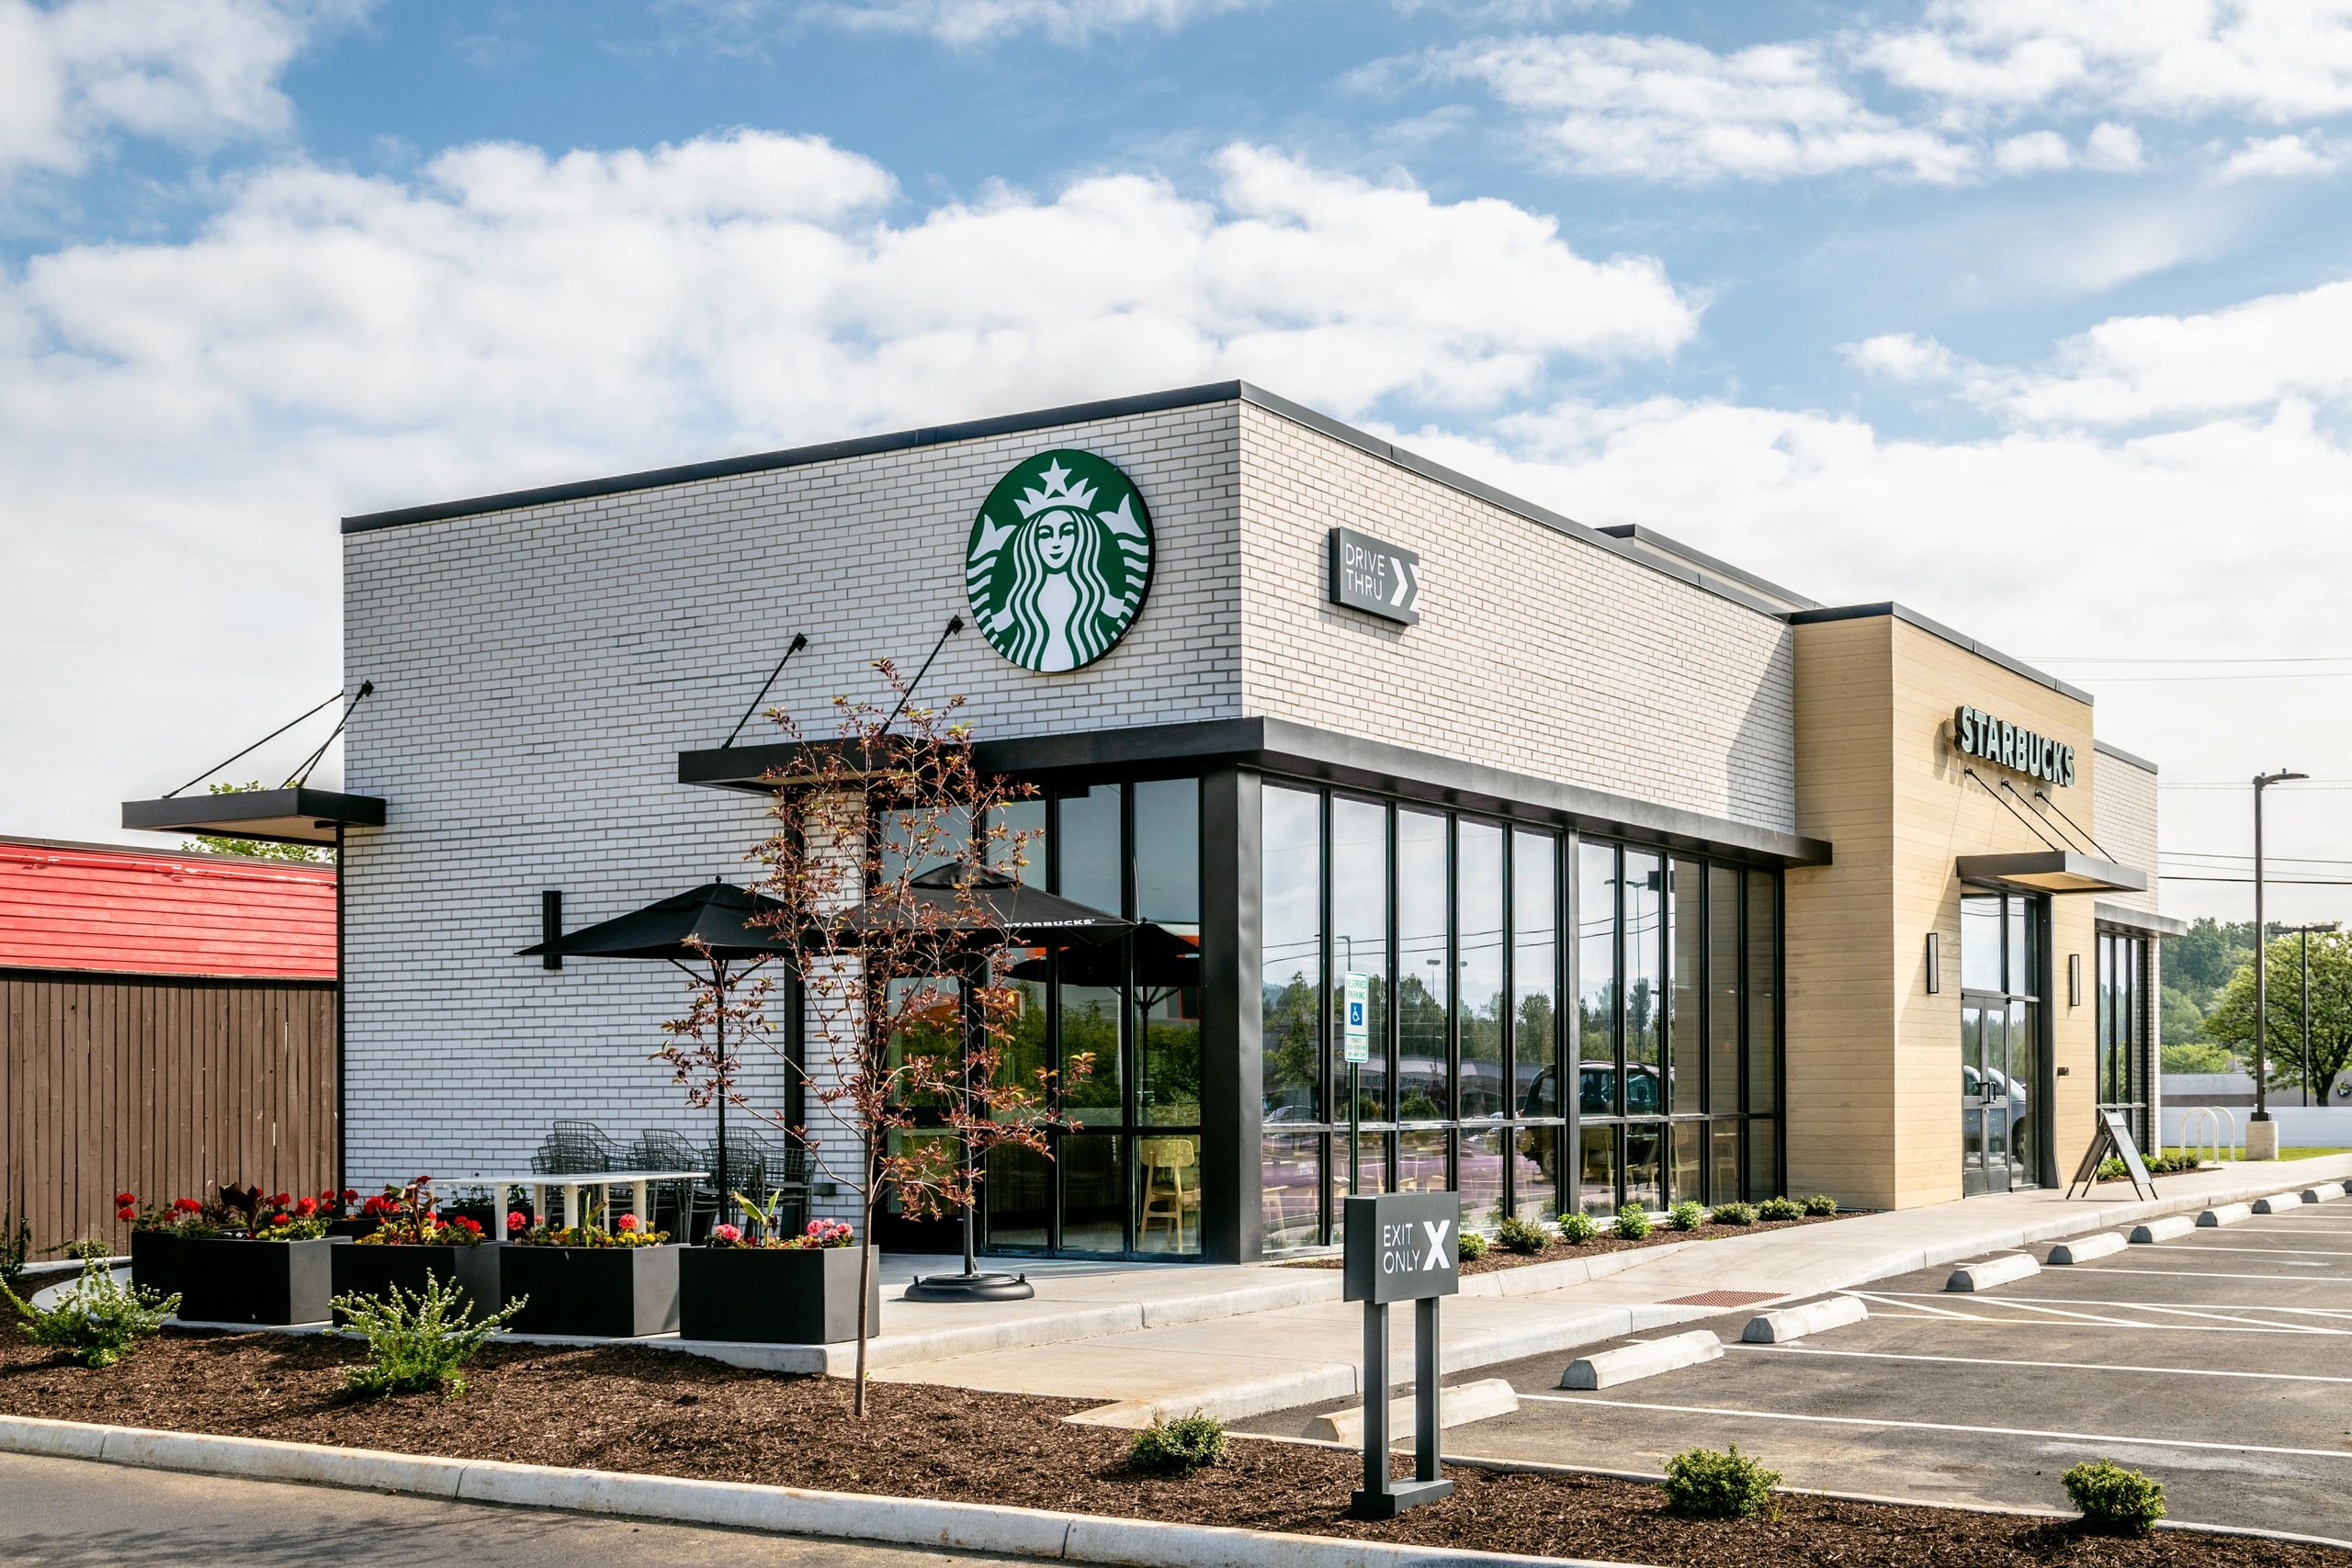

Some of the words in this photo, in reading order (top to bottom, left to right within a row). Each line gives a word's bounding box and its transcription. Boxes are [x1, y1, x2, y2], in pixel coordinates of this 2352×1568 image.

[1345, 543, 1385, 578] DRIVE
[1345, 568, 1384, 601] THRU
[1957, 705, 2075, 788] STARBUCKS
[1383, 1223, 1414, 1247] EXIT
[1383, 1249, 1421, 1275] ONLY
